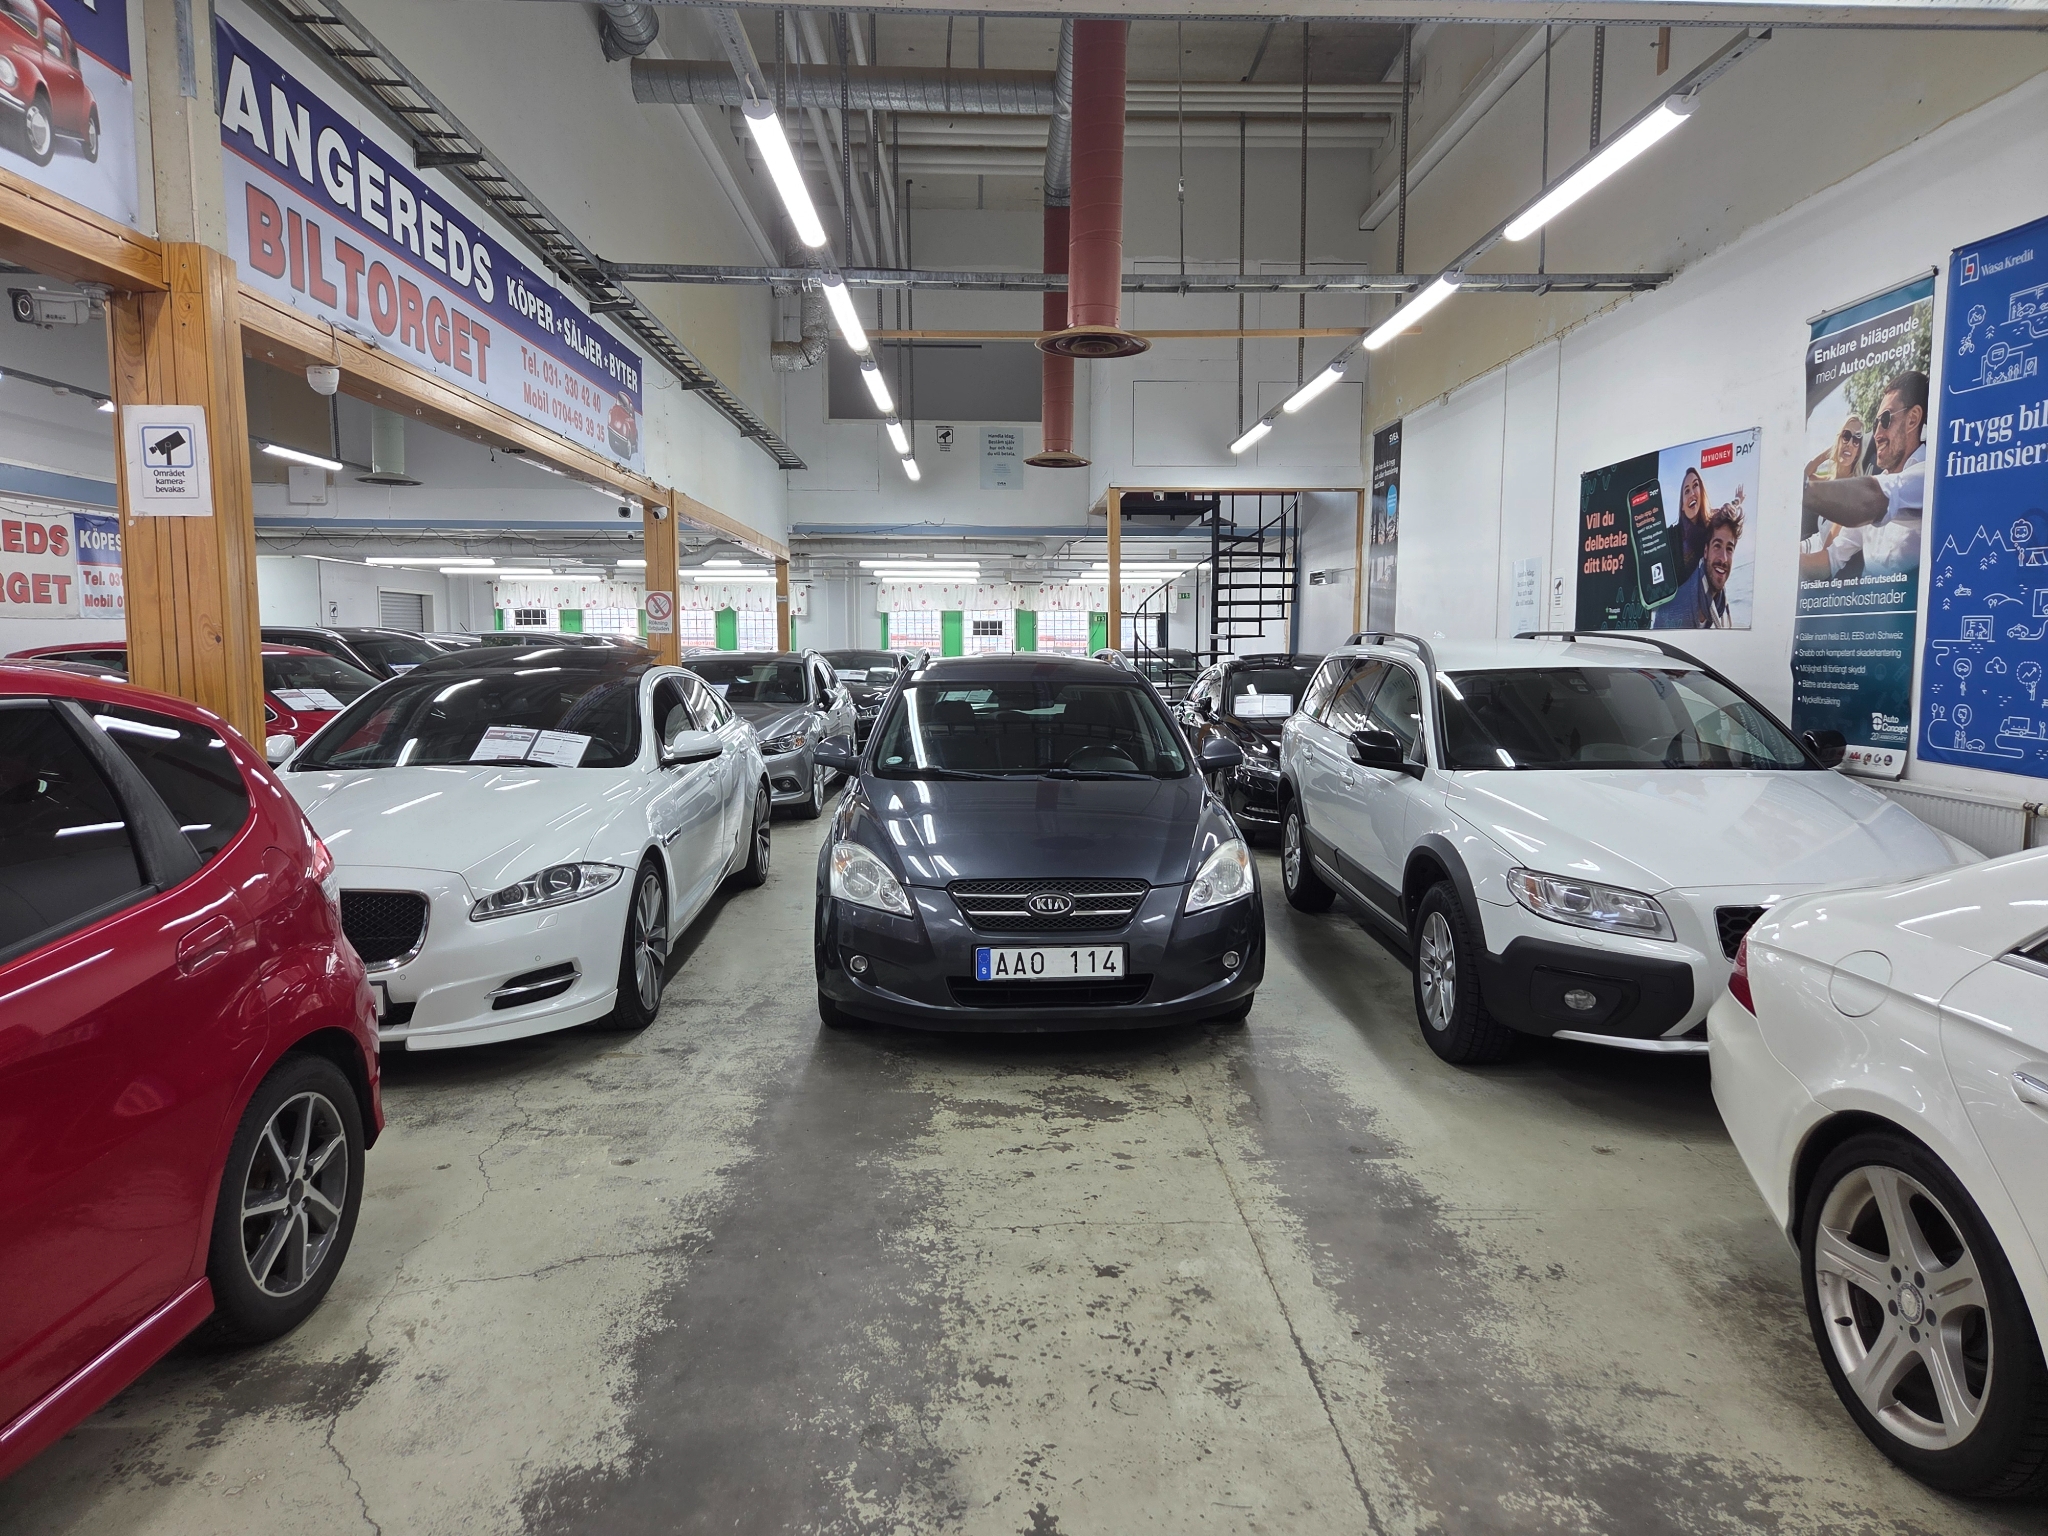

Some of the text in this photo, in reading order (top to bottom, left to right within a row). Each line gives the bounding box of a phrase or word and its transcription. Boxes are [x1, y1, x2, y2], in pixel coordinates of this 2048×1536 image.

[222, 54, 638, 393] ANGEREDS KÖPER SÄLJER BYTER
[1981, 249, 2034, 277] Wasa Kredit
[245, 182, 490, 384] BILTORGET
[1814, 316, 1920, 365] Enklare bilägande
[1815, 338, 1916, 385] med AutoConcept
[521, 346, 539, 378] Tel.
[564, 373, 579, 400] 330
[581, 385, 590, 408] 42
[592, 392, 601, 414] 40
[523, 381, 605, 443] Mobil 0704-69 39 35
[1948, 412, 2014, 447] Trygg
[1702, 442, 1755, 463] MYMONEY PAY
[1945, 440, 2048, 478] finansier
[153, 469, 185, 477] Området
[1586, 510, 1615, 530] Vill du
[0, 519, 70, 557] EDS
[1584, 531, 1628, 552] delbetala
[1584, 553, 1625, 575] ditt köp?
[0, 571, 72, 605] GET
[83, 570, 106, 586] Tel.
[1800, 572, 1908, 590] Försäkra dig mot oförutsedda
[84, 594, 113, 608] Mobil
[1799, 589, 1907, 611] reparationskostnader
[1814, 632, 1828, 641] inom
[1851, 631, 1864, 640] EES
[1864, 631, 1877, 640] och
[1877, 631, 1904, 640] Schweiz
[1798, 648, 1902, 658] Snabb och kompetent skadehantering
[1848, 665, 1866, 675] skydd
[1881, 723, 1909, 734] Concept
[1882, 714, 1899, 724] Auto
[1036, 898, 1065, 910] KIA
[995, 951, 1045, 976] AAO
[1070, 950, 1117, 974] 114
